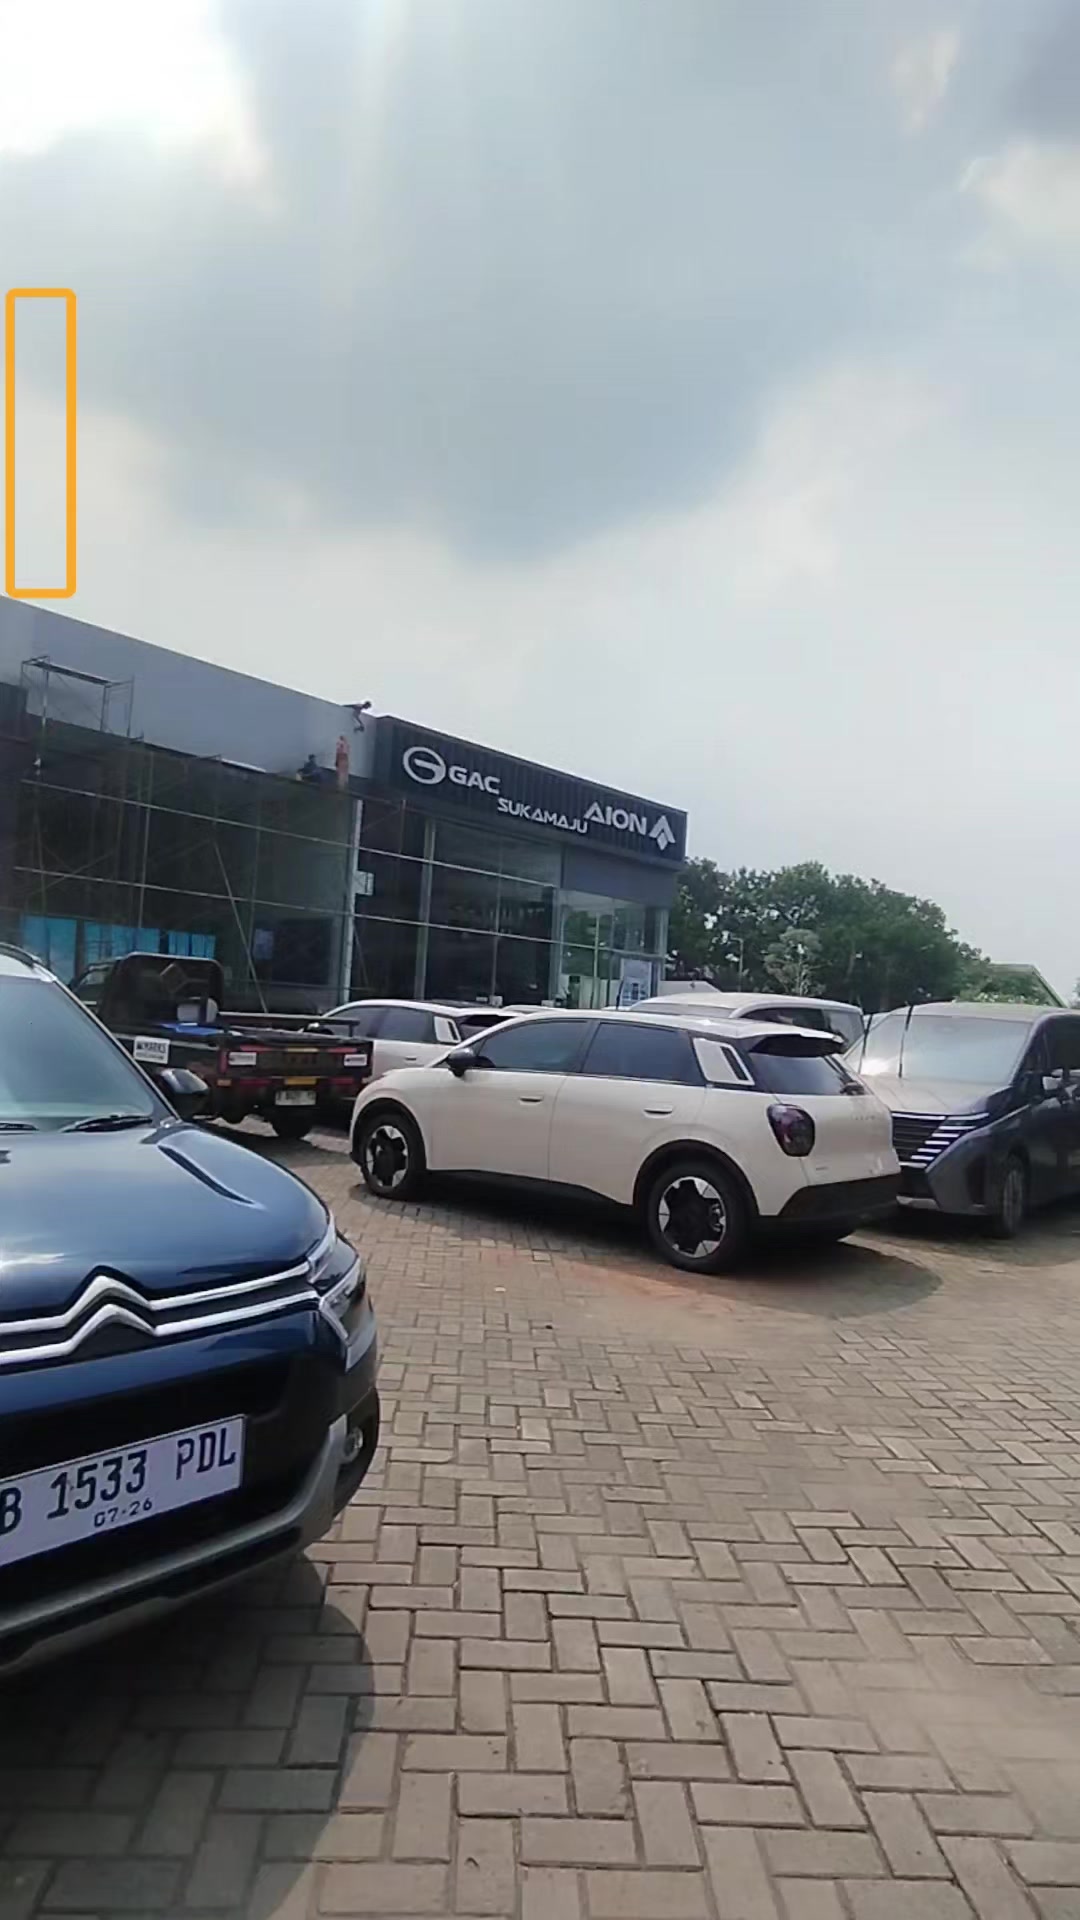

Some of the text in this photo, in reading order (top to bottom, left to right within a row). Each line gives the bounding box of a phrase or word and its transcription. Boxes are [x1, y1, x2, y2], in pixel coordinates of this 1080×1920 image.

[449, 766, 500, 795] GAC
[497, 797, 588, 834] SUKAMAJU
[583, 801, 647, 835] AION
[0, 1428, 236, 1536] B 1533 PDL
[93, 1497, 153, 1528] 07-26
